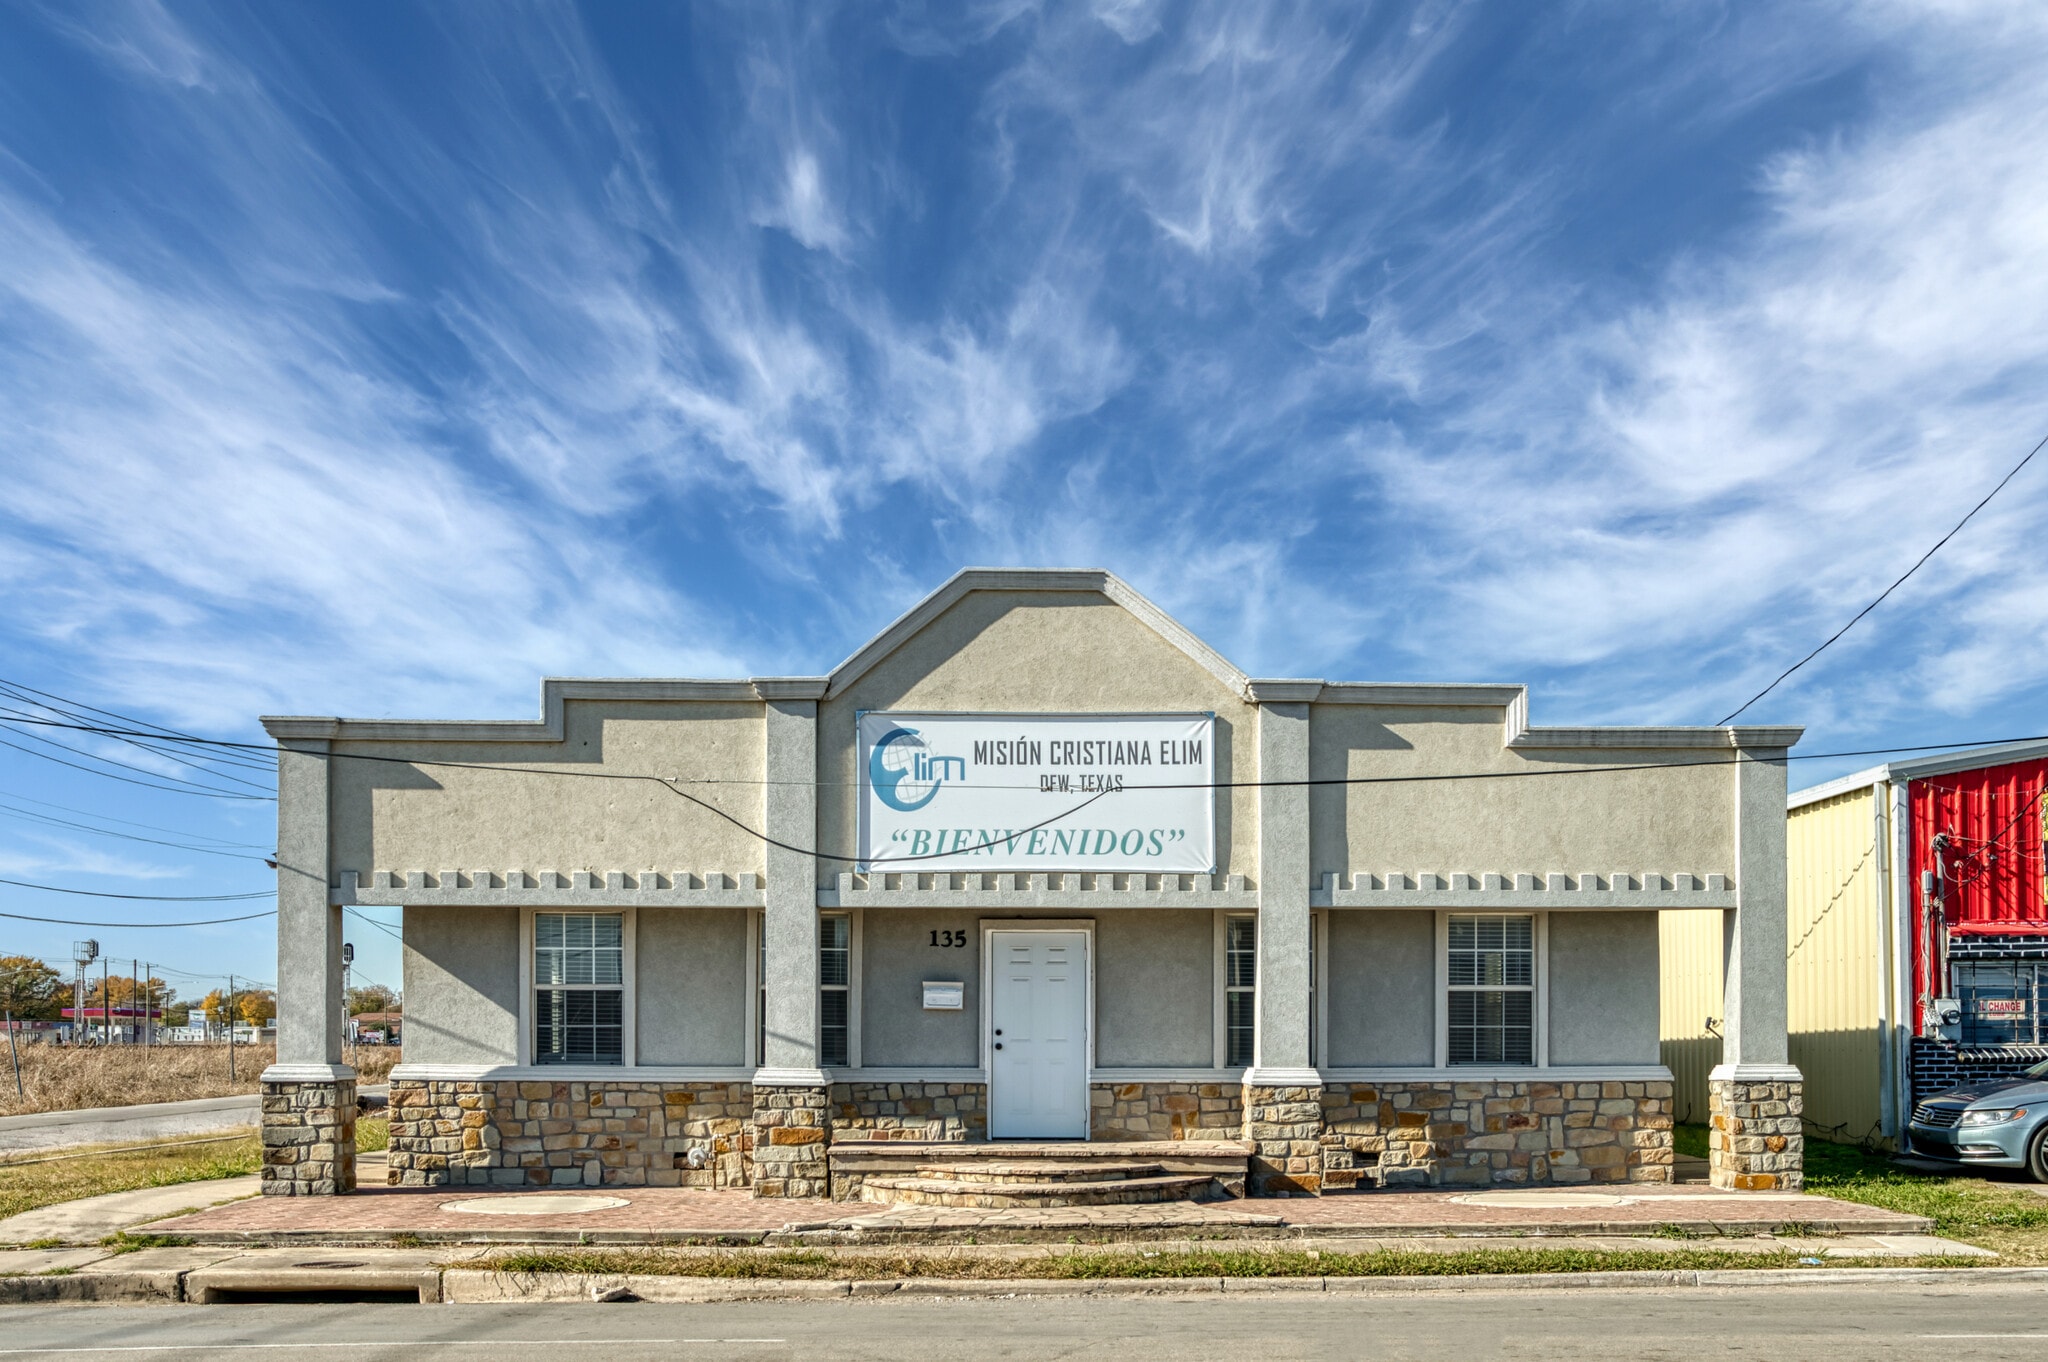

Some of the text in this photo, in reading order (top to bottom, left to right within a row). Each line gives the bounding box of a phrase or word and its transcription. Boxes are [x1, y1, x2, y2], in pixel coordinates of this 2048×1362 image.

[974, 736, 1203, 765] MISIÓN CRISTIANA ELIM
[1040, 774, 1123, 794] DFW, TEXAS
[891, 828, 1186, 856] “BIENVENIDOS”
[929, 930, 967, 948] 135
[1988, 1002, 2021, 1011] CHANGE
